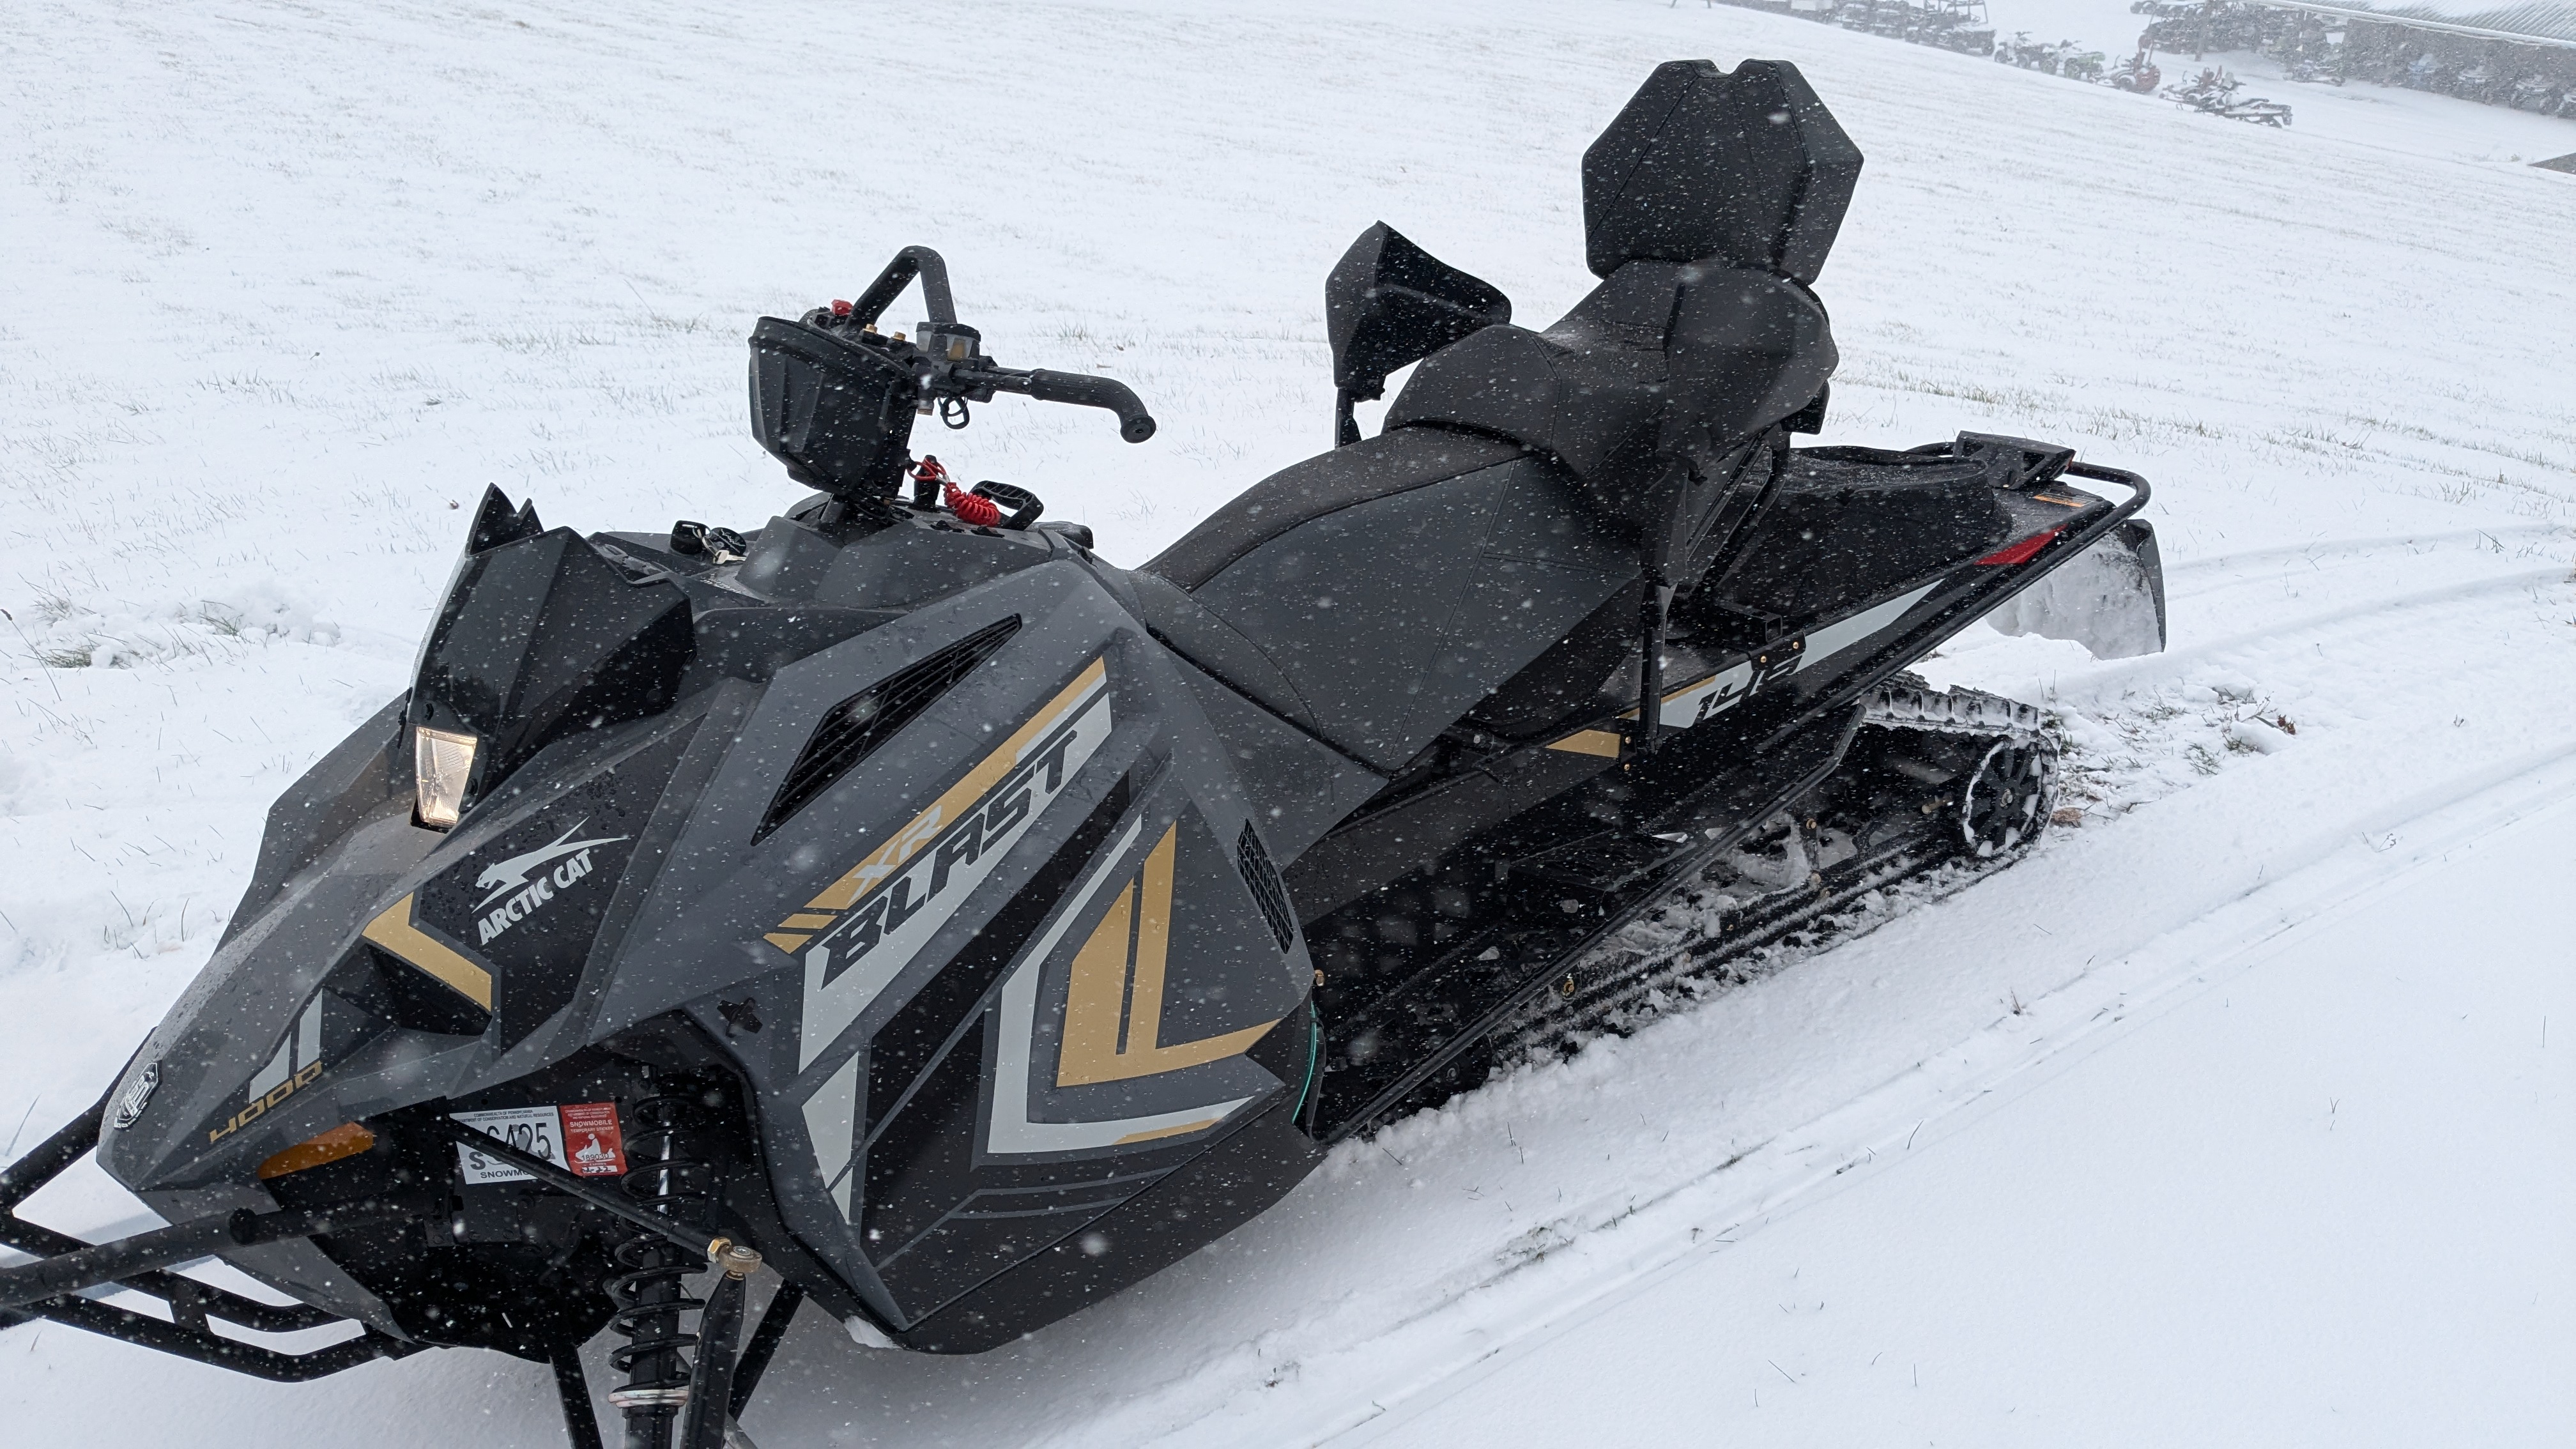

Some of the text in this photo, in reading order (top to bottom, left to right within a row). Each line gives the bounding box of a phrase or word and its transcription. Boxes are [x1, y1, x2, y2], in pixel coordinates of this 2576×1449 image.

[478, 848, 593, 946] ARCTIC CAT
[820, 730, 1078, 990] BLAST
[847, 805, 942, 905] XR
[209, 1060, 323, 1142] 4000
[570, 1119, 613, 1128] SNOWMOBILE
[468, 1151, 486, 1170] S
